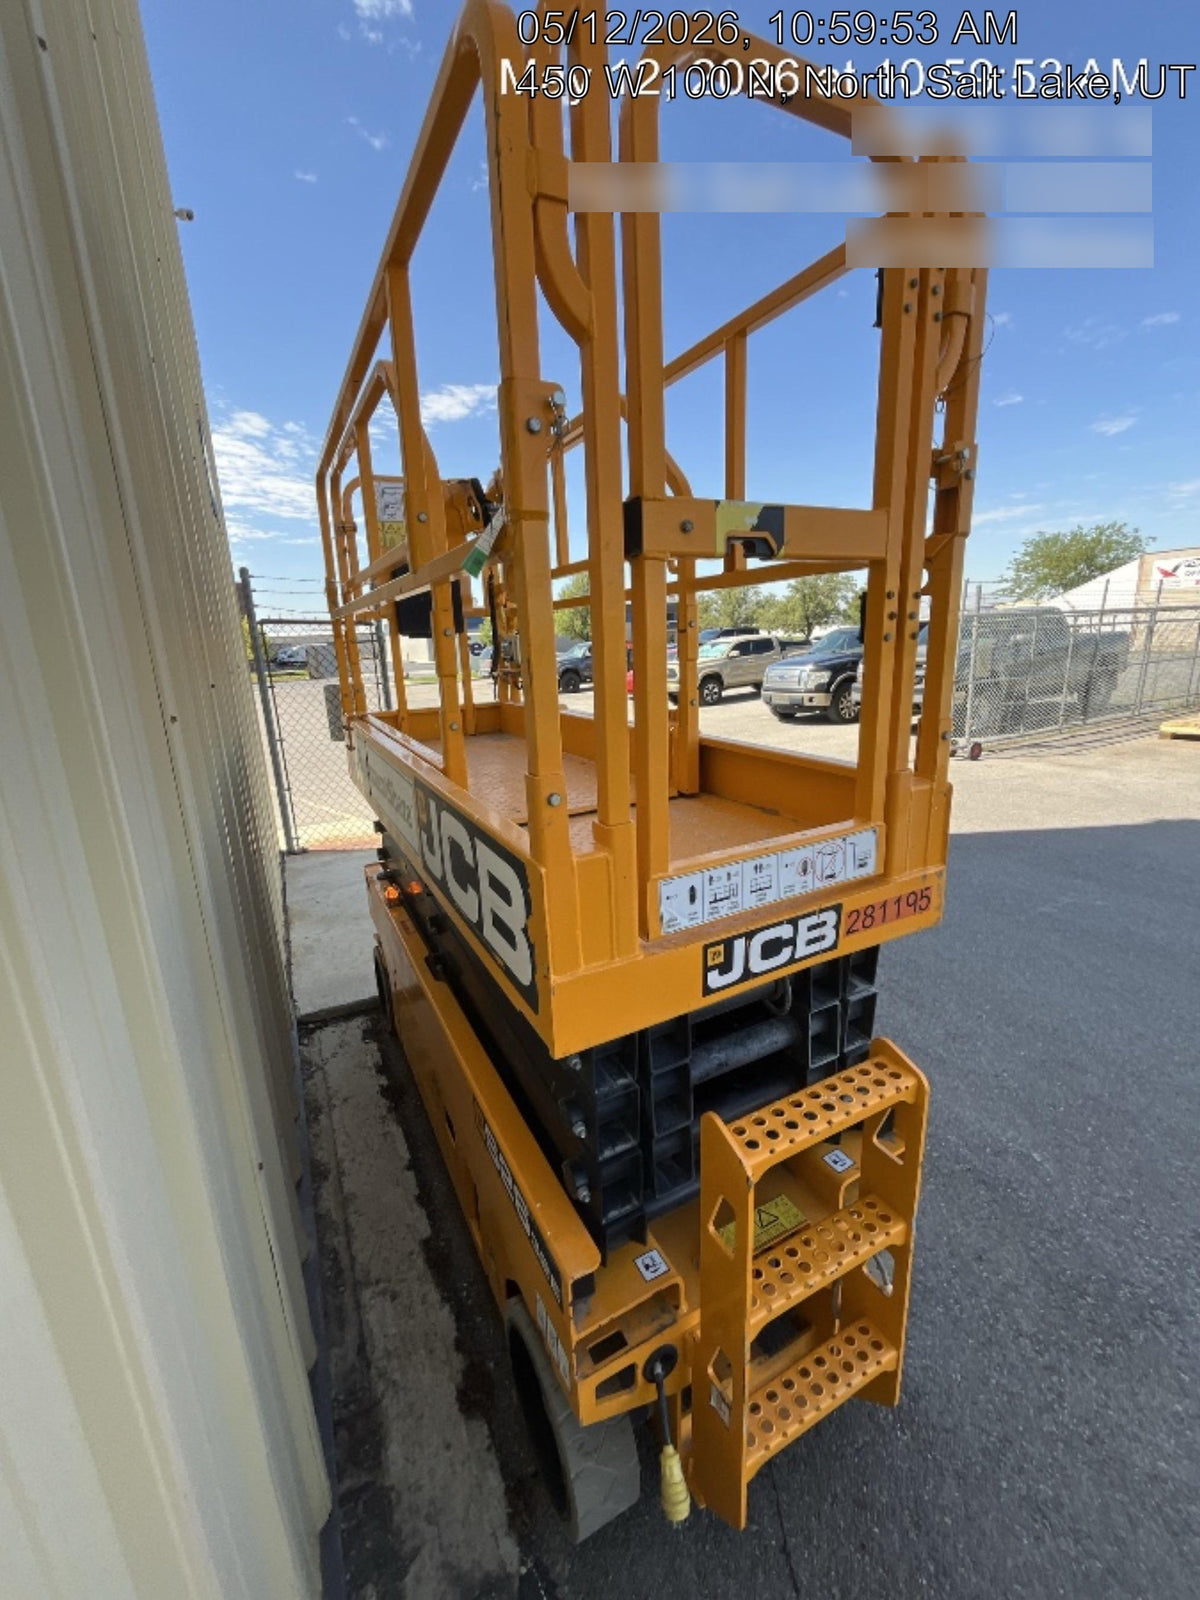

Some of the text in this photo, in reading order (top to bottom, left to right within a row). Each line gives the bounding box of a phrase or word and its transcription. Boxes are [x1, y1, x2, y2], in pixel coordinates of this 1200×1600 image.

[418, 795, 533, 987] JCB
[845, 885, 932, 937] 281195
[706, 907, 839, 990] JCB
